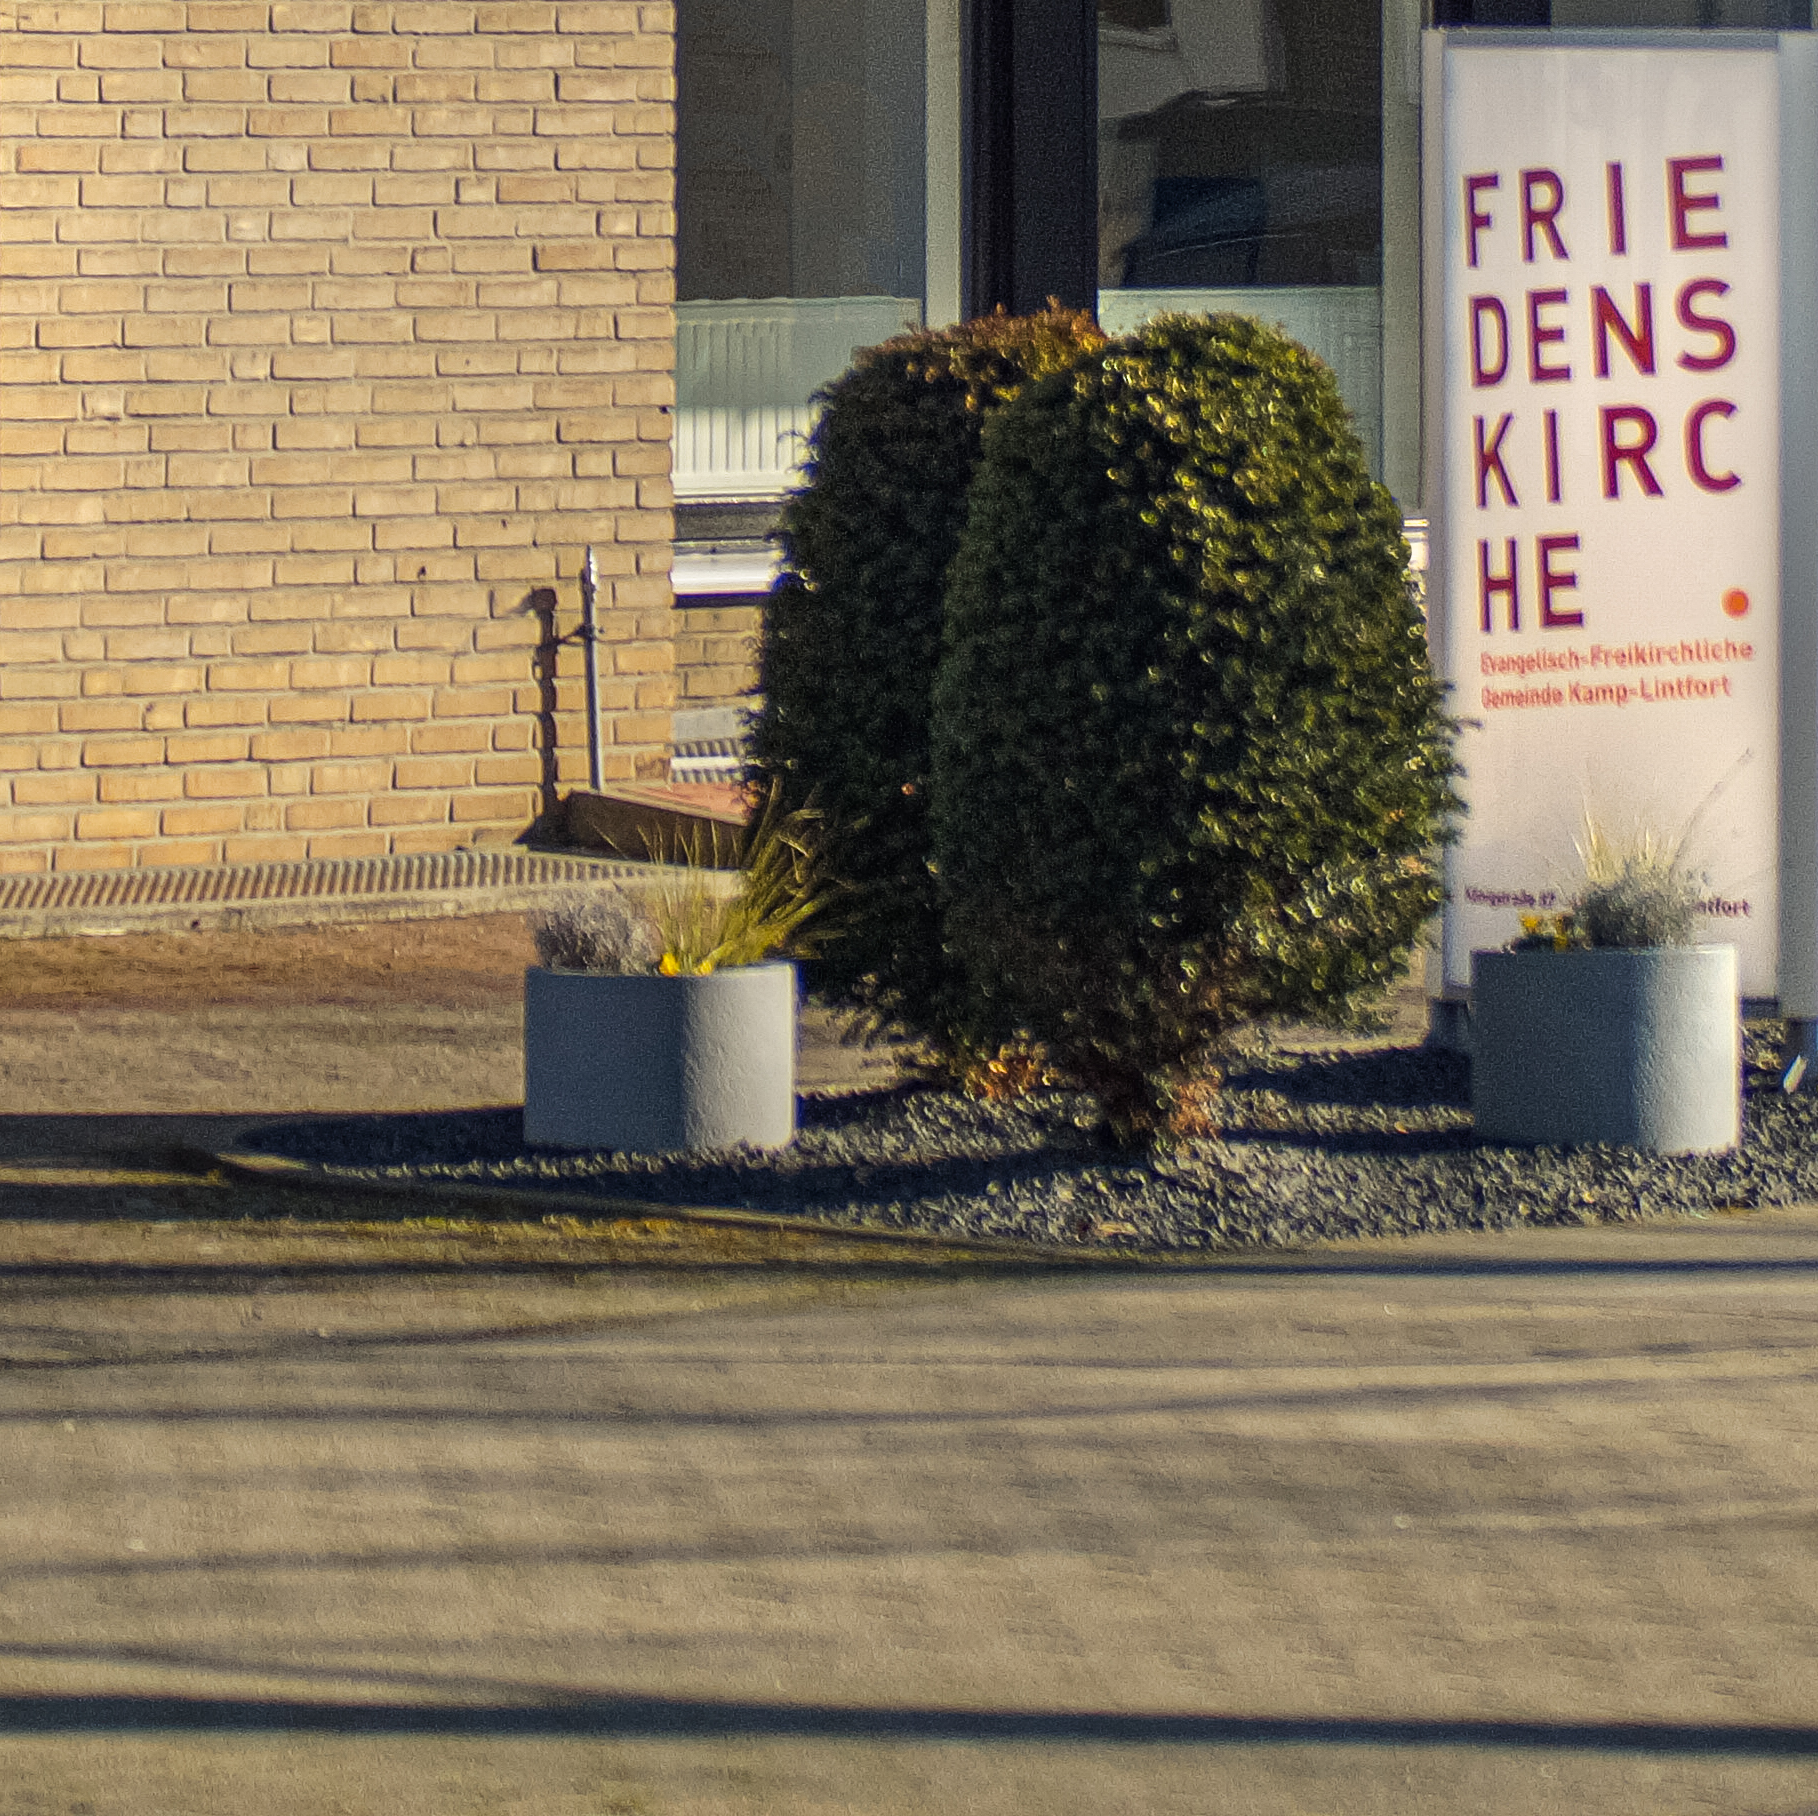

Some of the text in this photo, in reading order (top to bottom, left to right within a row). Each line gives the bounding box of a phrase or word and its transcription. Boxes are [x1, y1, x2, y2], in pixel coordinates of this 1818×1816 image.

[1462, 155, 1728, 268] FRIE
[1467, 277, 1738, 388] DENS
[1472, 397, 1742, 509] KIRC
[1477, 532, 1584, 633] HE
[1480, 638, 1754, 677] Evangelisch-Freikirchliche
[1481, 675, 1732, 709] Gemeinde Kamp-Lintfort
